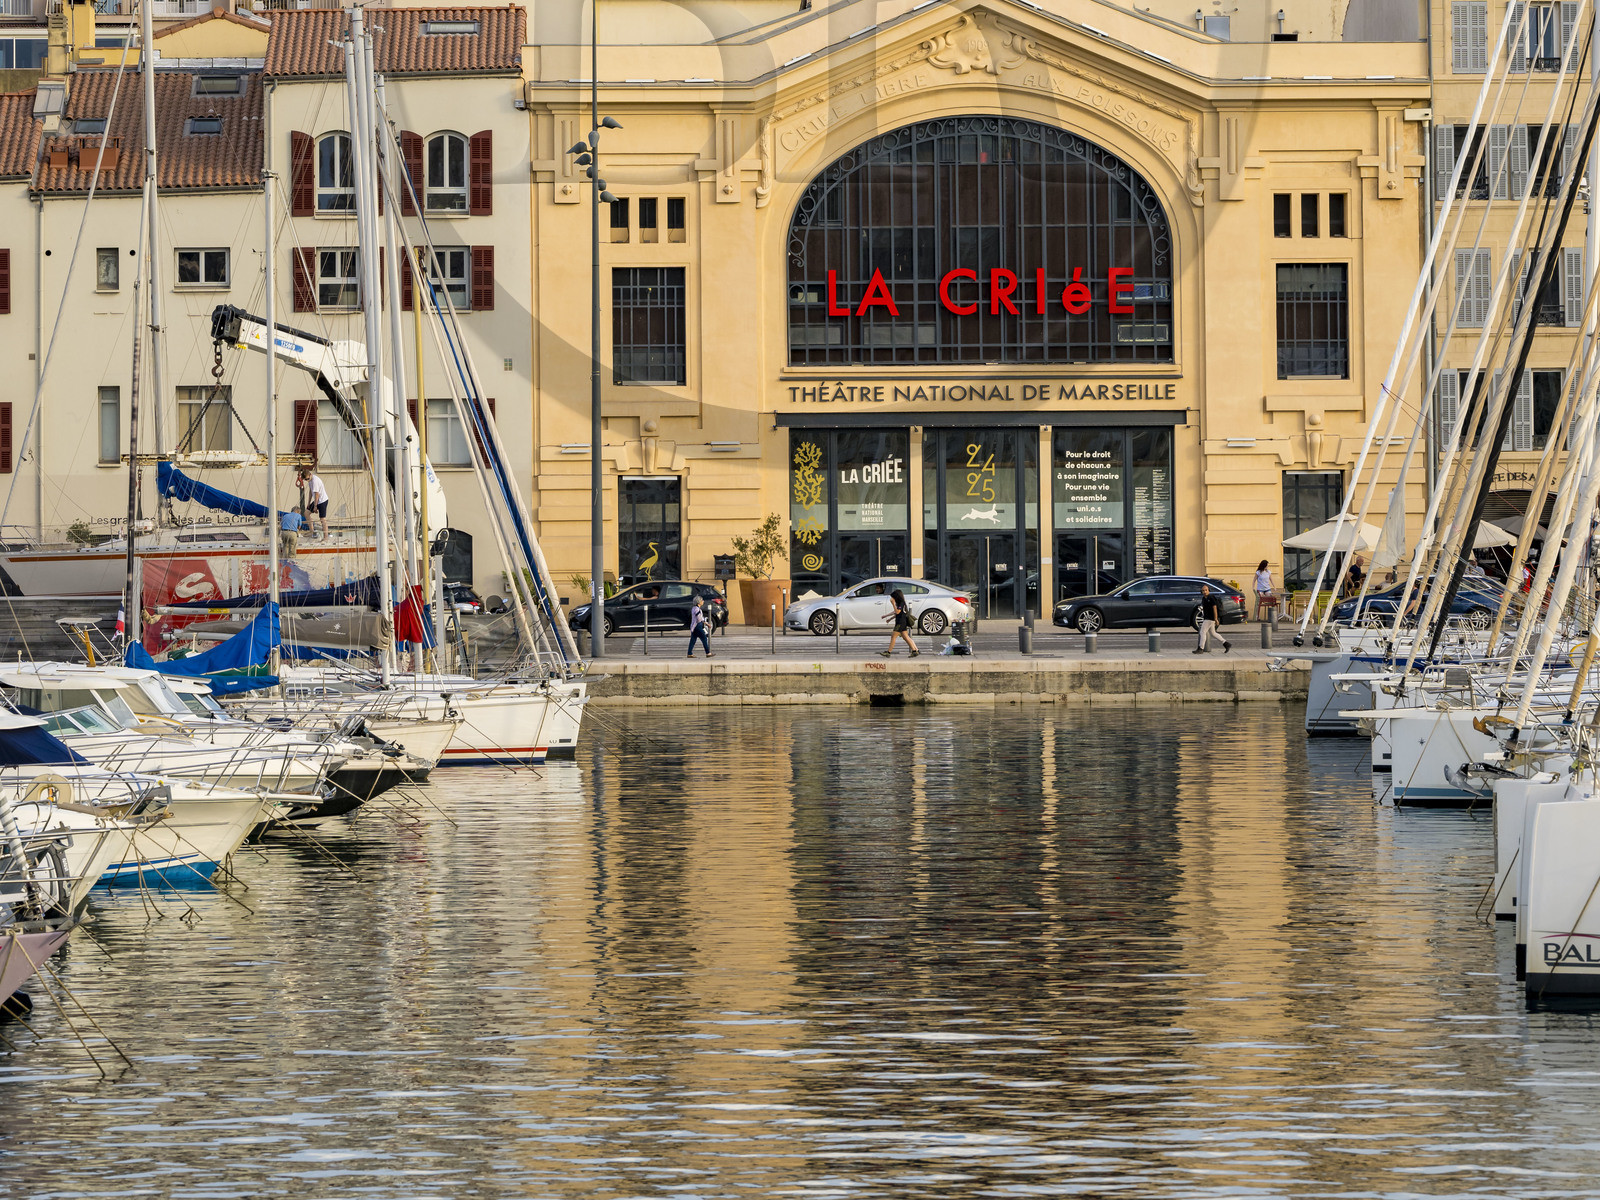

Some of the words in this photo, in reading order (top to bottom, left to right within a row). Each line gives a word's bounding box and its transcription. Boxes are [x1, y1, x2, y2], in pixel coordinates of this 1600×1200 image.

[860, 74, 928, 105] LIBRE
[1022, 73, 1065, 92] AUX
[1075, 86, 1178, 152] POISSONS
[827, 267, 900, 317] LA
[939, 266, 1135, 316] CRIéE
[788, 380, 885, 403] THÉÂTRE
[893, 384, 1014, 402] NATIONAL
[1022, 384, 1051, 401] DE
[1058, 383, 1176, 401] MARSEILLE
[841, 470, 859, 484] LA
[862, 454, 903, 484] CRIÉE
[1078, 473, 1119, 481] imaginaire
[1507, 472, 1528, 481] DES
[90, 516, 109, 524] Les
[198, 515, 212, 524] de
[217, 514, 230, 524] La
